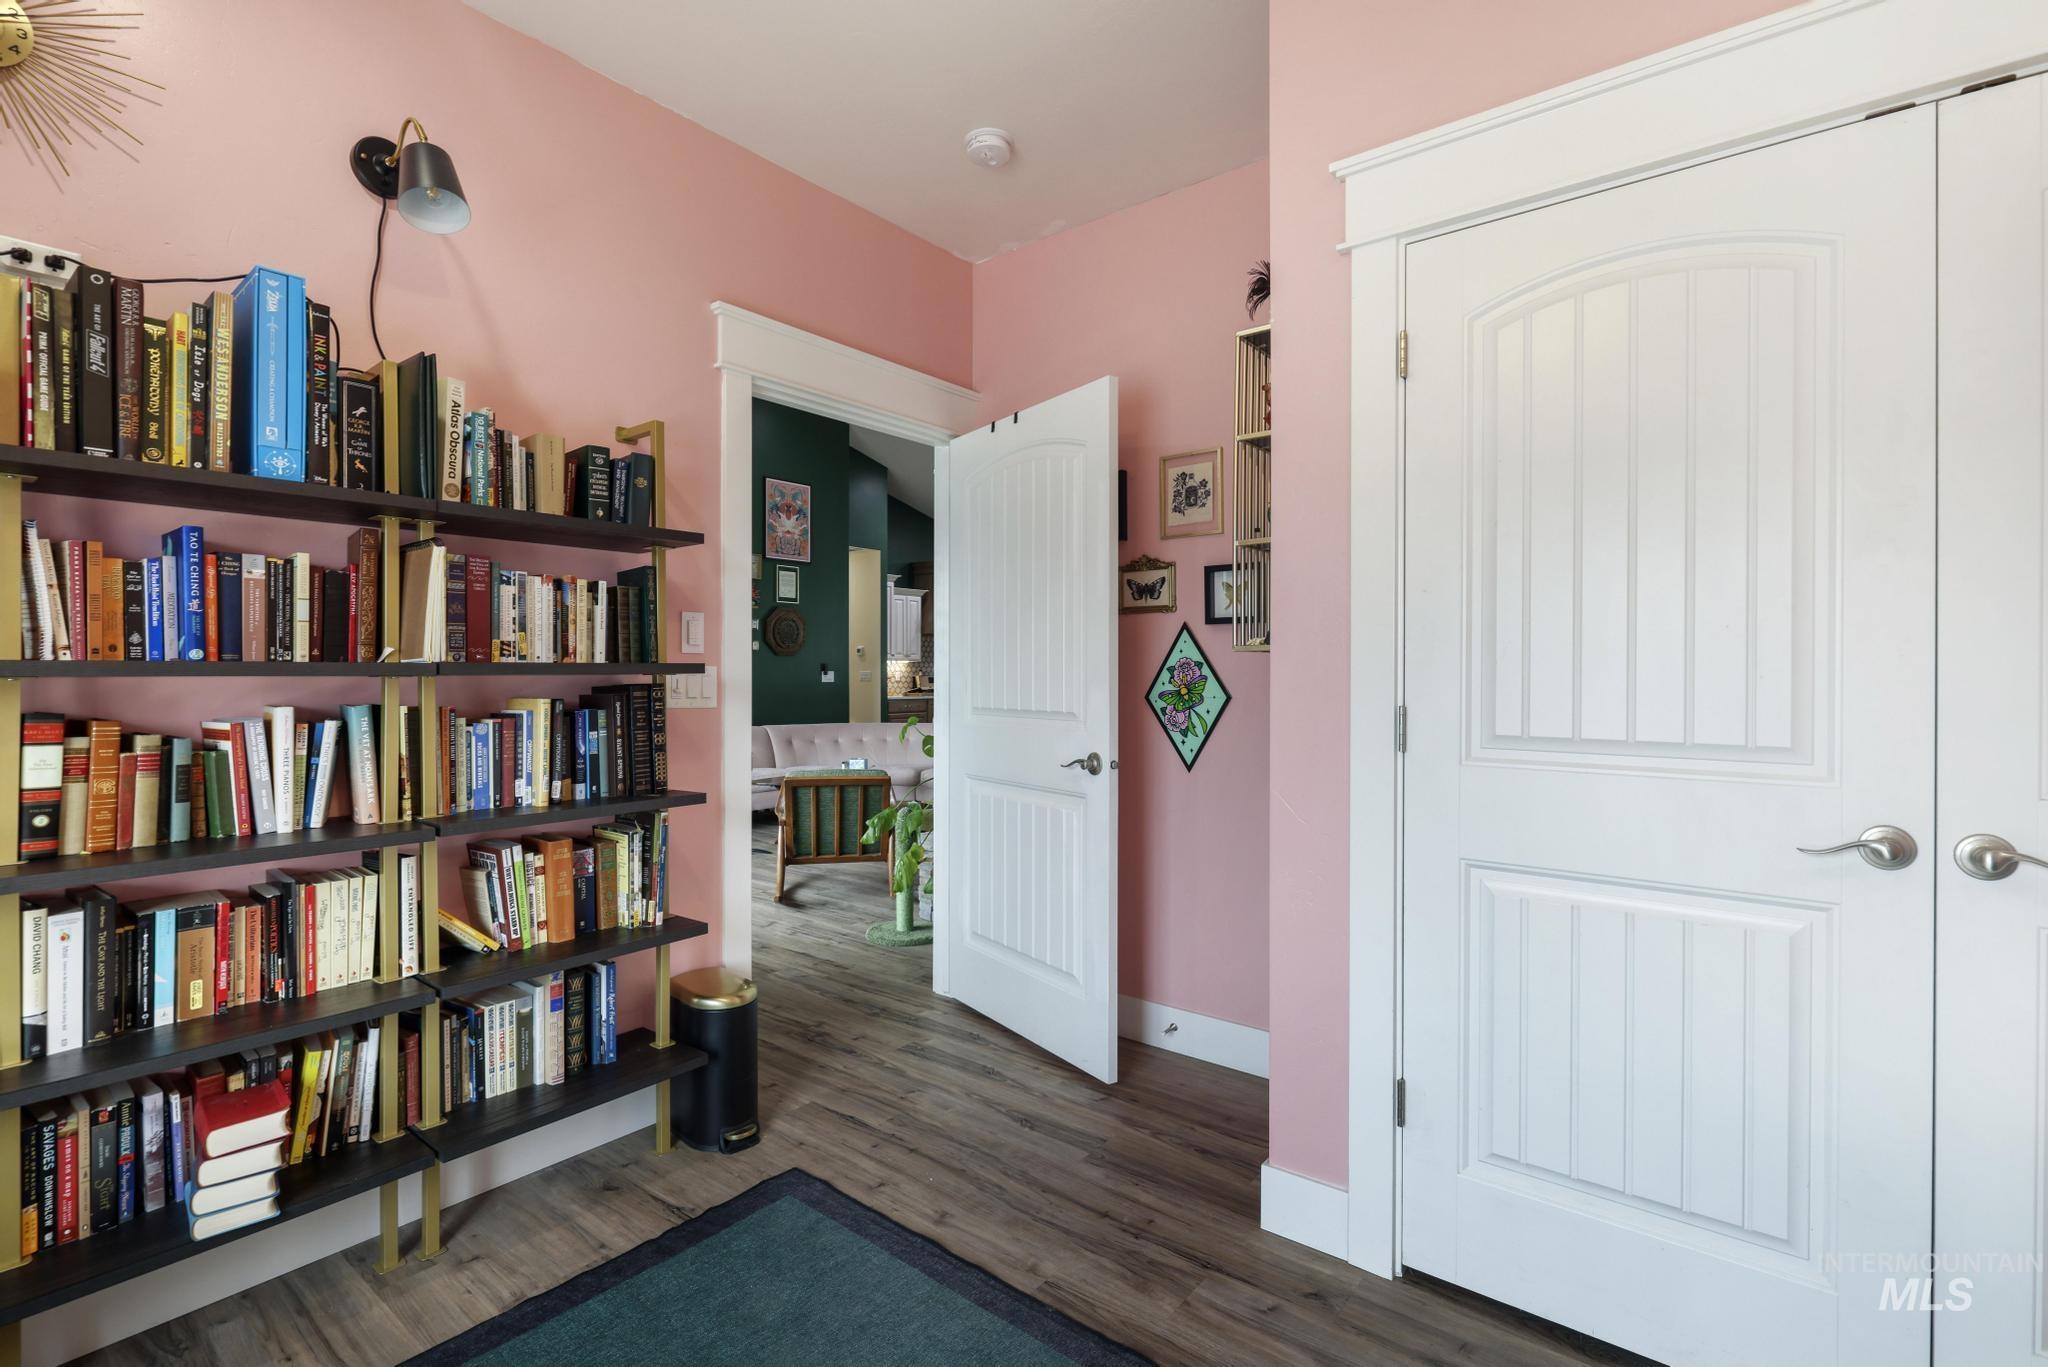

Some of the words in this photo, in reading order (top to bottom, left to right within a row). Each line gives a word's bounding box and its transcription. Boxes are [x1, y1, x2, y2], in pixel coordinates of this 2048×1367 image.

[8, 45, 21, 56] 4
[121, 286, 132, 325] MARTIN
[131, 288, 140, 312] GEORGE
[90, 332, 107, 363] Fallout
[176, 330, 186, 346] HART
[216, 328, 230, 354] WES
[314, 334, 326, 352] INK
[40, 353, 48, 376] OFFICIAL
[63, 349, 71, 364] GAME
[194, 345, 206, 365] Isle
[40, 377, 48, 394] GAME
[63, 375, 71, 384] THE
[216, 355, 229, 420] ANDERSON
[314, 363, 327, 397] PAINT
[63, 387, 72, 400] YEAR
[120, 393, 132, 408] ICE
[192, 380, 205, 402] Dogs
[40, 394, 48, 411] GUIDE
[63, 402, 71, 424] EDITION
[131, 409, 140, 432] WORLD
[450, 399, 462, 429] Atlas
[478, 416, 485, 425] 10
[120, 418, 131, 439] FIRE
[348, 448, 372, 457] THRONES
[448, 431, 461, 479] Obscura
[477, 479, 485, 497] Parks
[190, 532, 199, 548] TAO
[190, 553, 199, 562] TE
[190, 565, 200, 596] CHING
[152, 601, 160, 627] Tradition
[167, 591, 176, 629] MEDITATION
[361, 716, 369, 732] THE
[362, 734, 370, 747] VET
[322, 742, 331, 764] ETHICS
[363, 749, 370, 760] AT
[260, 763, 269, 782] CROSS
[365, 761, 374, 787] NOAH'S
[314, 780, 325, 817] ONTOLOGY
[367, 788, 375, 804] ARK
[526, 861, 535, 888] JUSTICE
[32, 916, 41, 942] DAVID
[98, 931, 107, 945] THE
[513, 929, 519, 937] UP
[32, 943, 41, 975] CHANG
[97, 945, 106, 961] CAVE
[190, 943, 199, 975] Aristotle
[97, 963, 106, 977] AND
[97, 979, 105, 991] THE
[95, 992, 105, 1011] LIGHT
[607, 993, 615, 1010] Robert
[121, 1102, 131, 1126] Annie
[43, 1124, 55, 1171] SAVAGES
[121, 1127, 131, 1156] PROULX
[65, 1164, 71, 1175] on
[44, 1174, 53, 1190] DON
[63, 1182, 71, 1197] map
[119, 1172, 129, 1192] Shipping
[44, 1190, 53, 1227] WINSLOW
[121, 1192, 130, 1211] News
